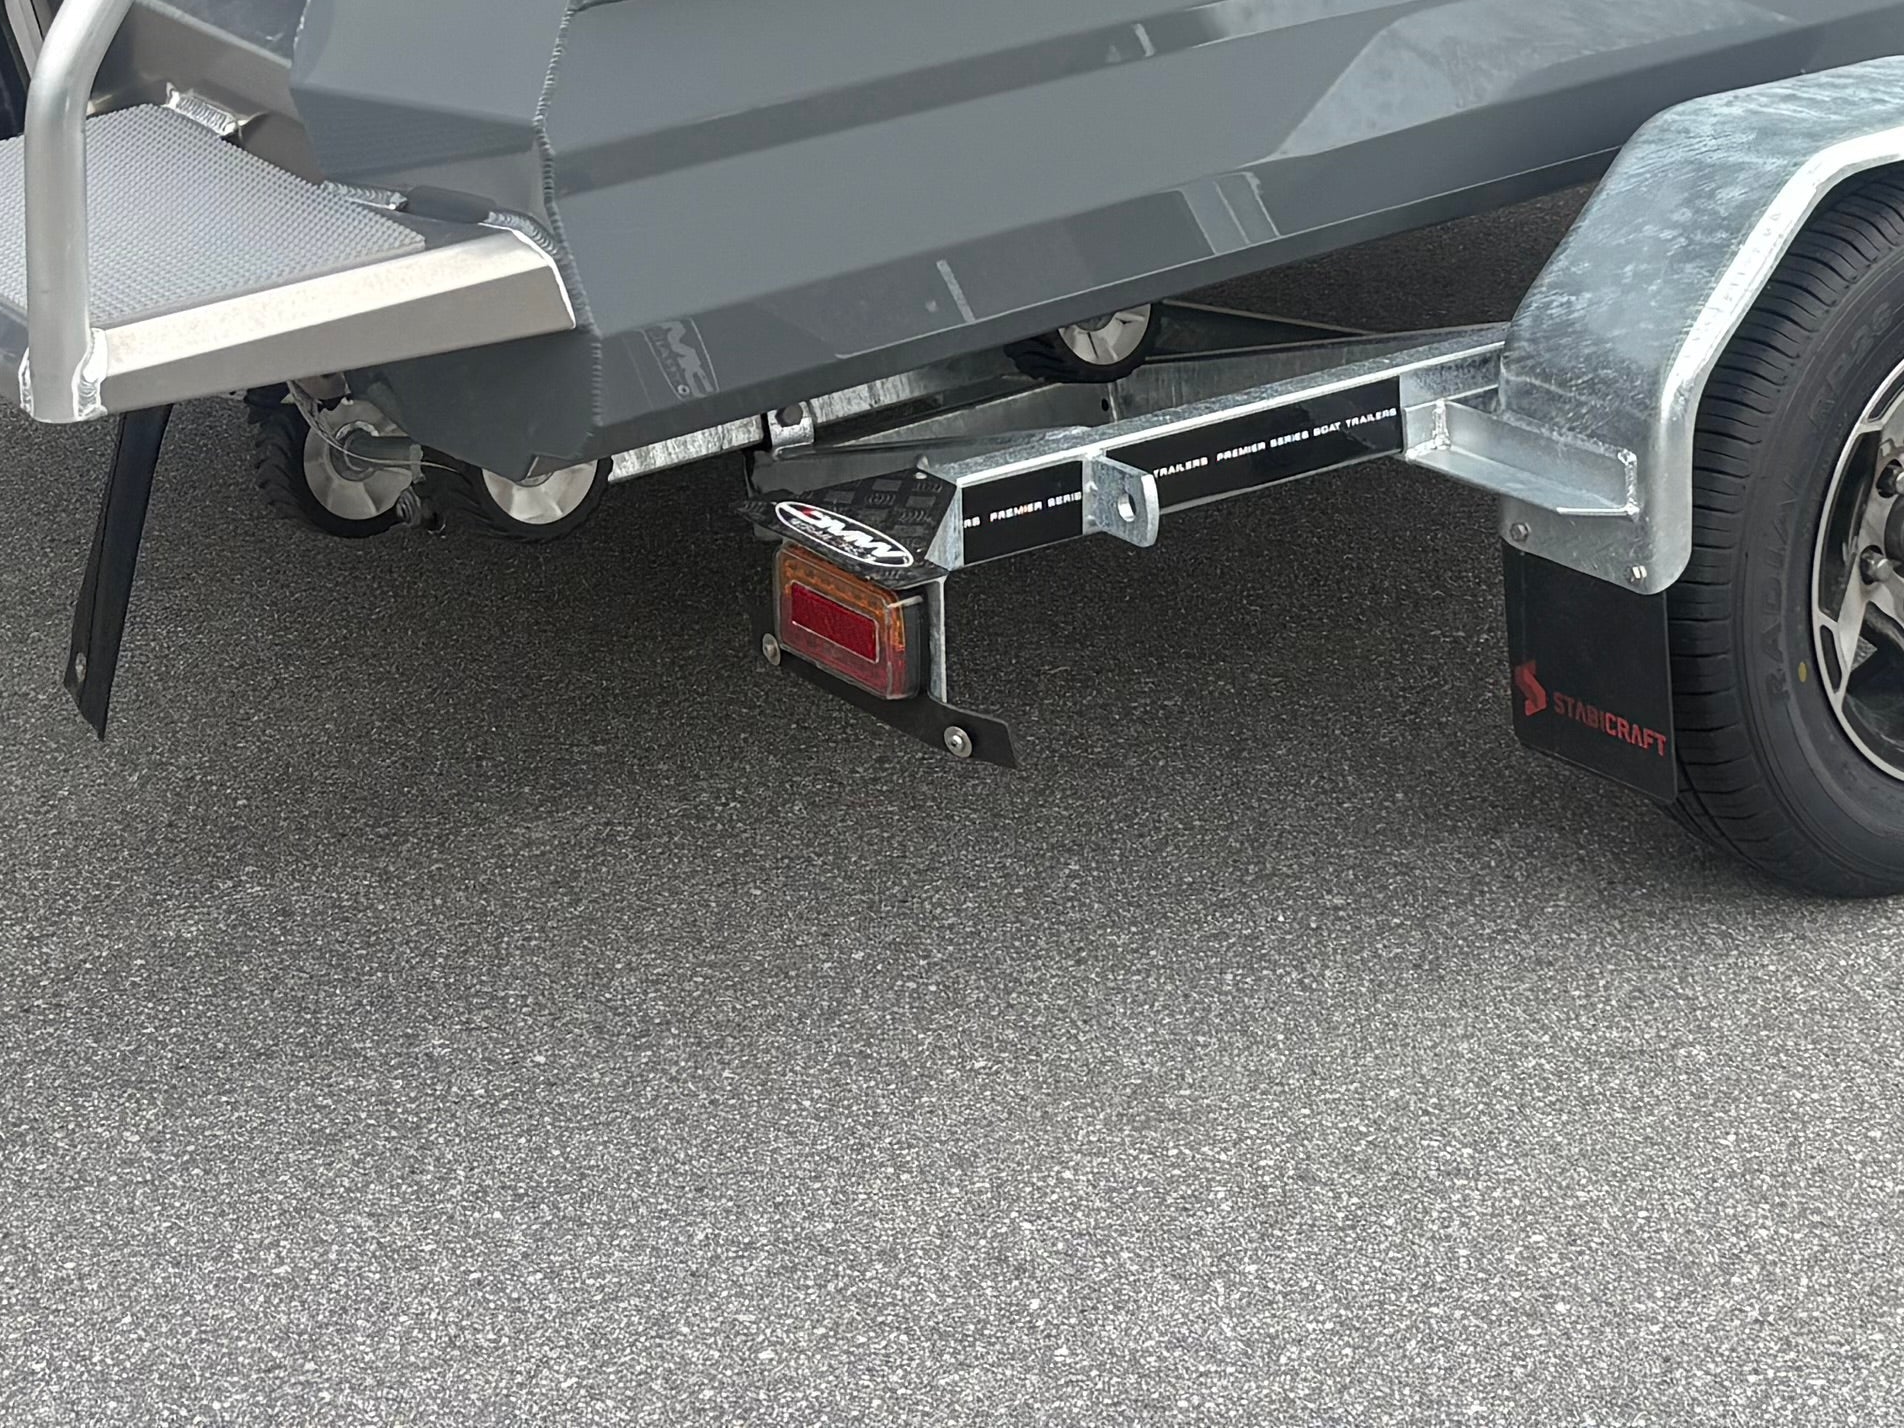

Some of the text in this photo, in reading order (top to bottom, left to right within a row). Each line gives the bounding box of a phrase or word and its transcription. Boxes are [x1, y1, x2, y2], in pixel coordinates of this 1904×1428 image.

[1216, 441, 1267, 462] PREMIER
[1269, 429, 1310, 449] SERIES
[1312, 421, 1342, 438] BOAT
[1345, 406, 1398, 428] TRAILERS
[989, 500, 1043, 523] PREMIER
[1552, 691, 1667, 757] STABICRAFT
